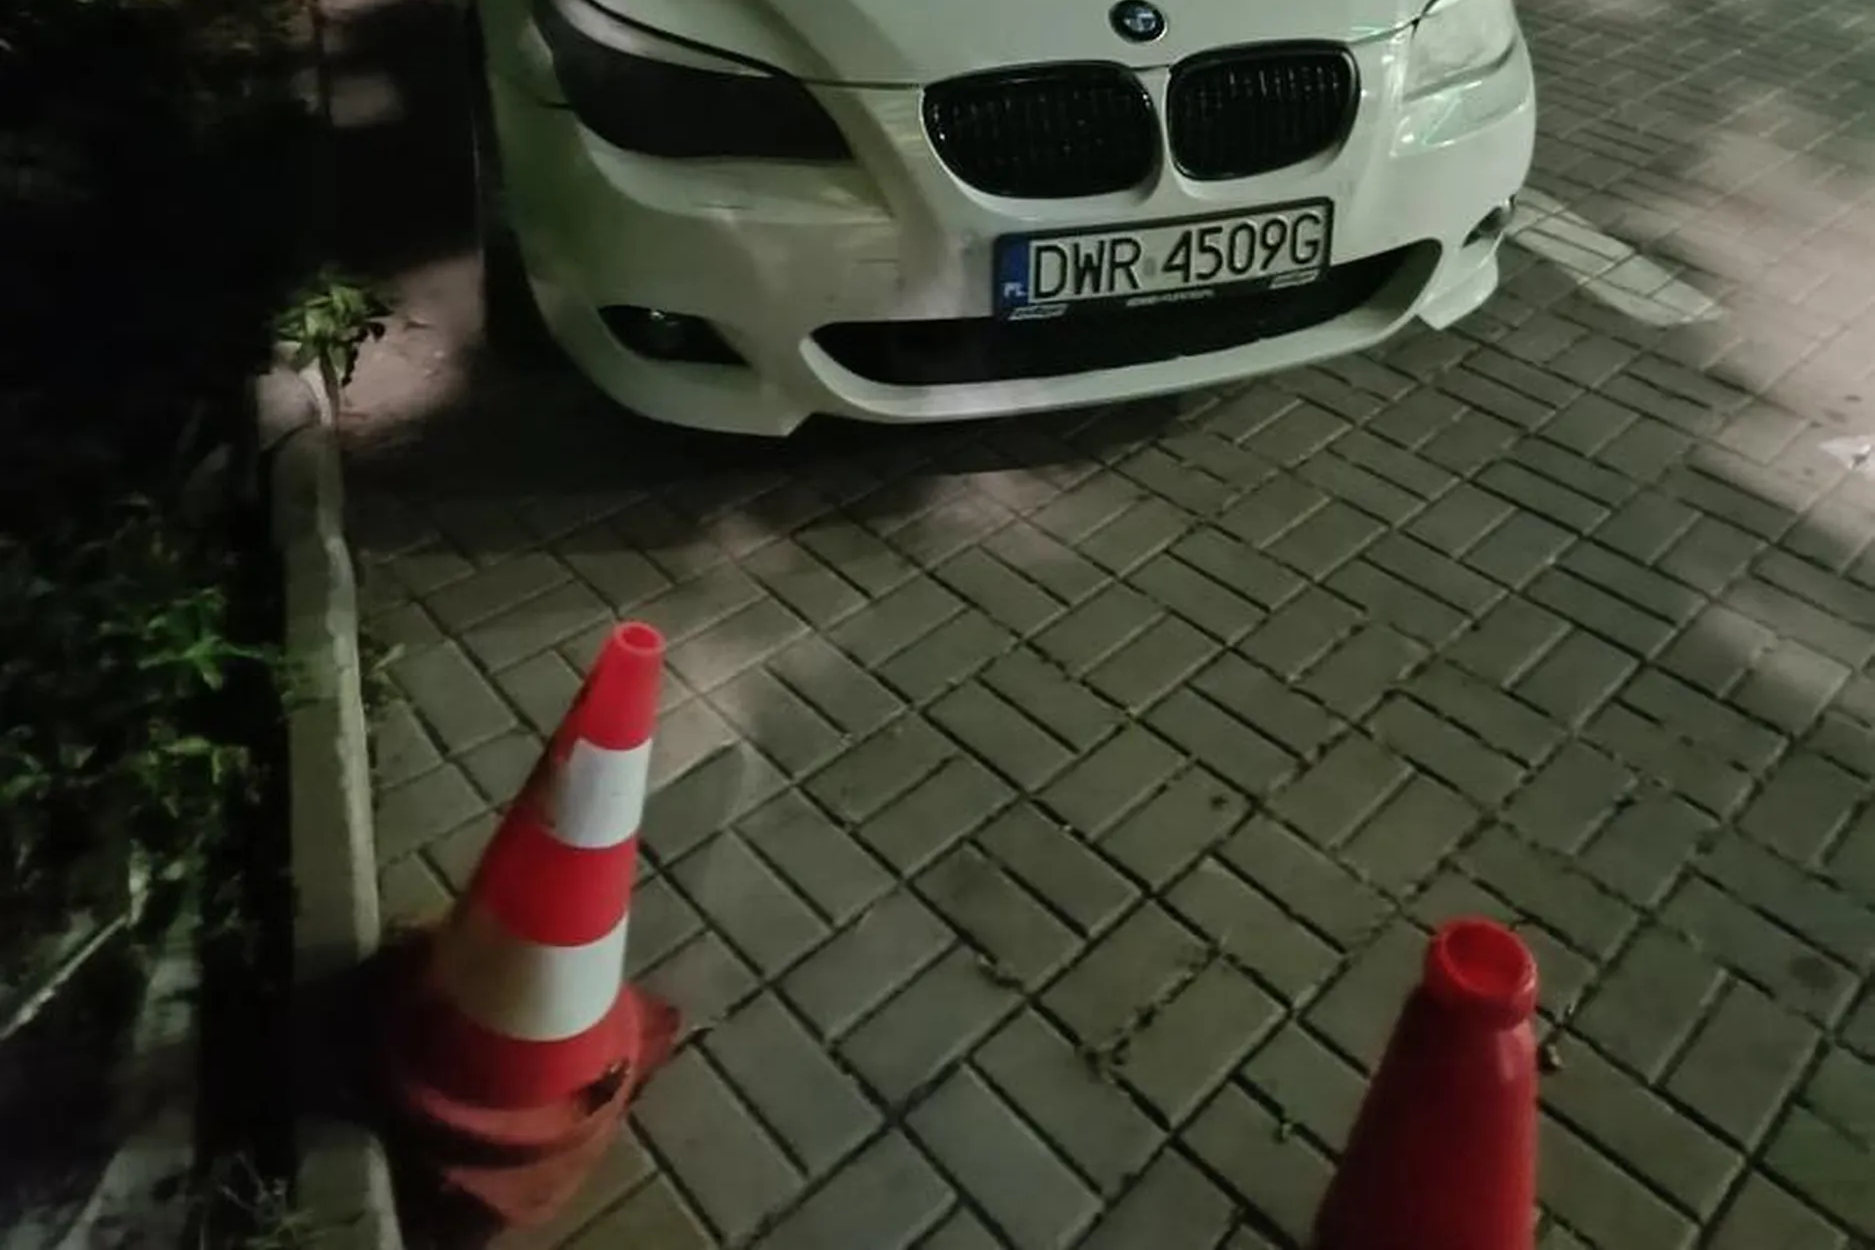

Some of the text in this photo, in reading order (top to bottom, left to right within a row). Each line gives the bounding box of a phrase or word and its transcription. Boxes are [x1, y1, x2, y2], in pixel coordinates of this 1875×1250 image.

[1033, 213, 1321, 299] DWR 4509G
[1003, 282, 1026, 297] PL
